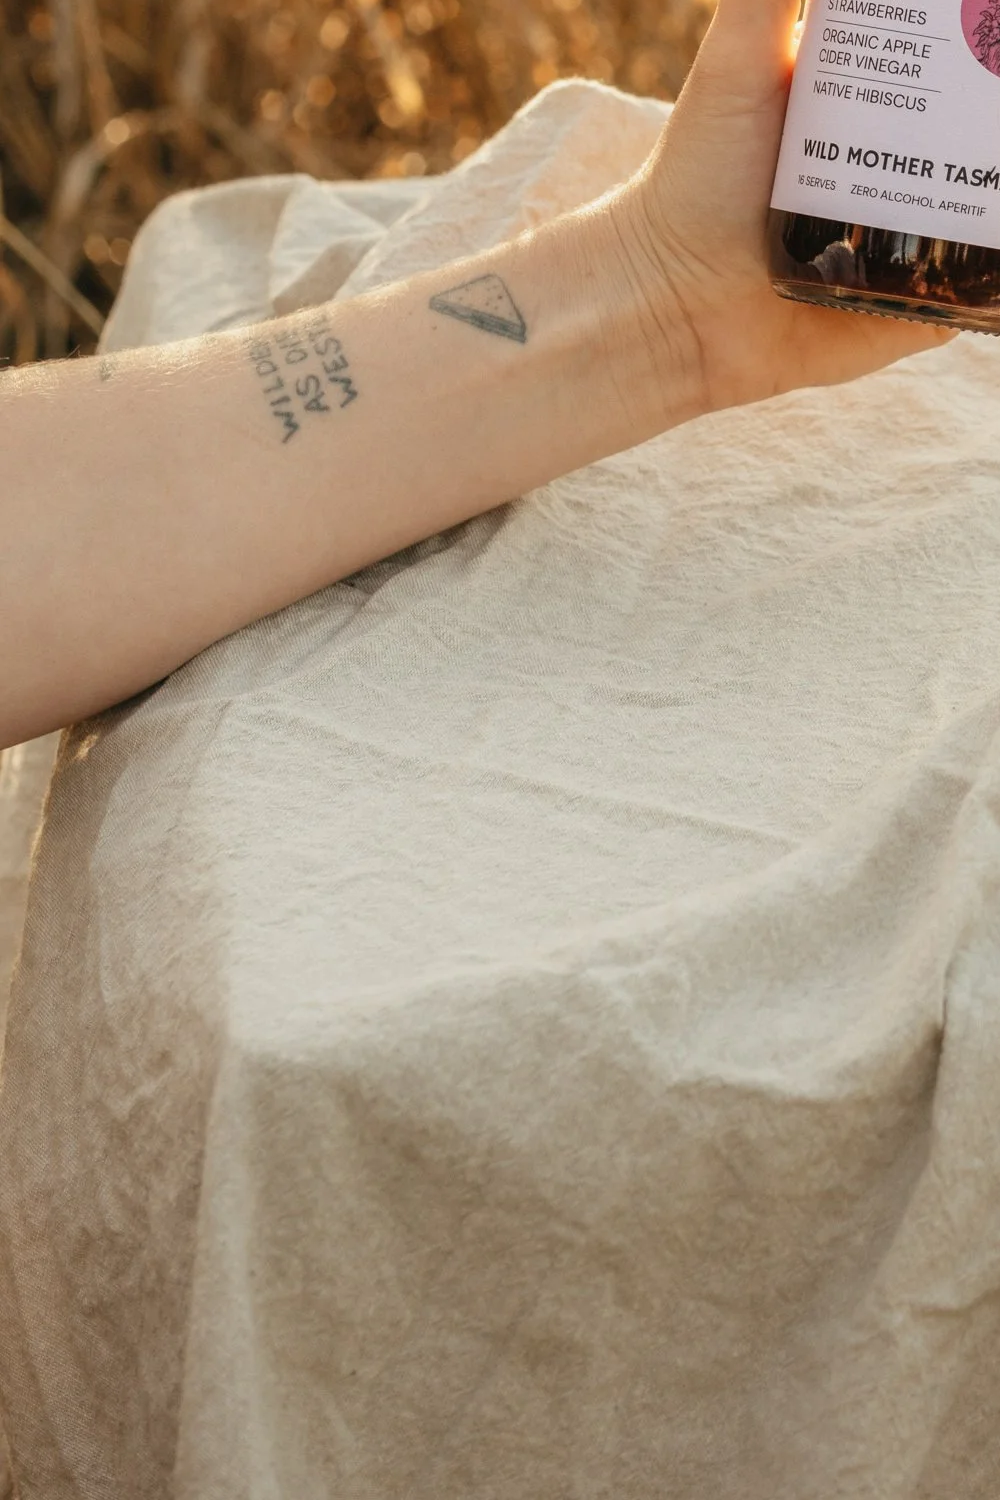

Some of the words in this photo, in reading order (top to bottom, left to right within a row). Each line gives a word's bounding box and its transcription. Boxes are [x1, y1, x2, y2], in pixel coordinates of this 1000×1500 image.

[822, 28, 879, 50] ORGANIC
[882, 38, 932, 59] APPLE
[819, 48, 852, 67] CIDER
[855, 54, 922, 78] VINEGAR
[813, 80, 853, 99] NATIVE
[855, 87, 927, 112] HIBISCUS
[804, 138, 839, 161] WILD
[846, 146, 935, 178] MOTHER
[805, 175, 836, 190] SERVES
[850, 184, 878, 198] ZERO
[880, 190, 935, 209] ALCOHOL
[938, 200, 987, 217] APERITIF
